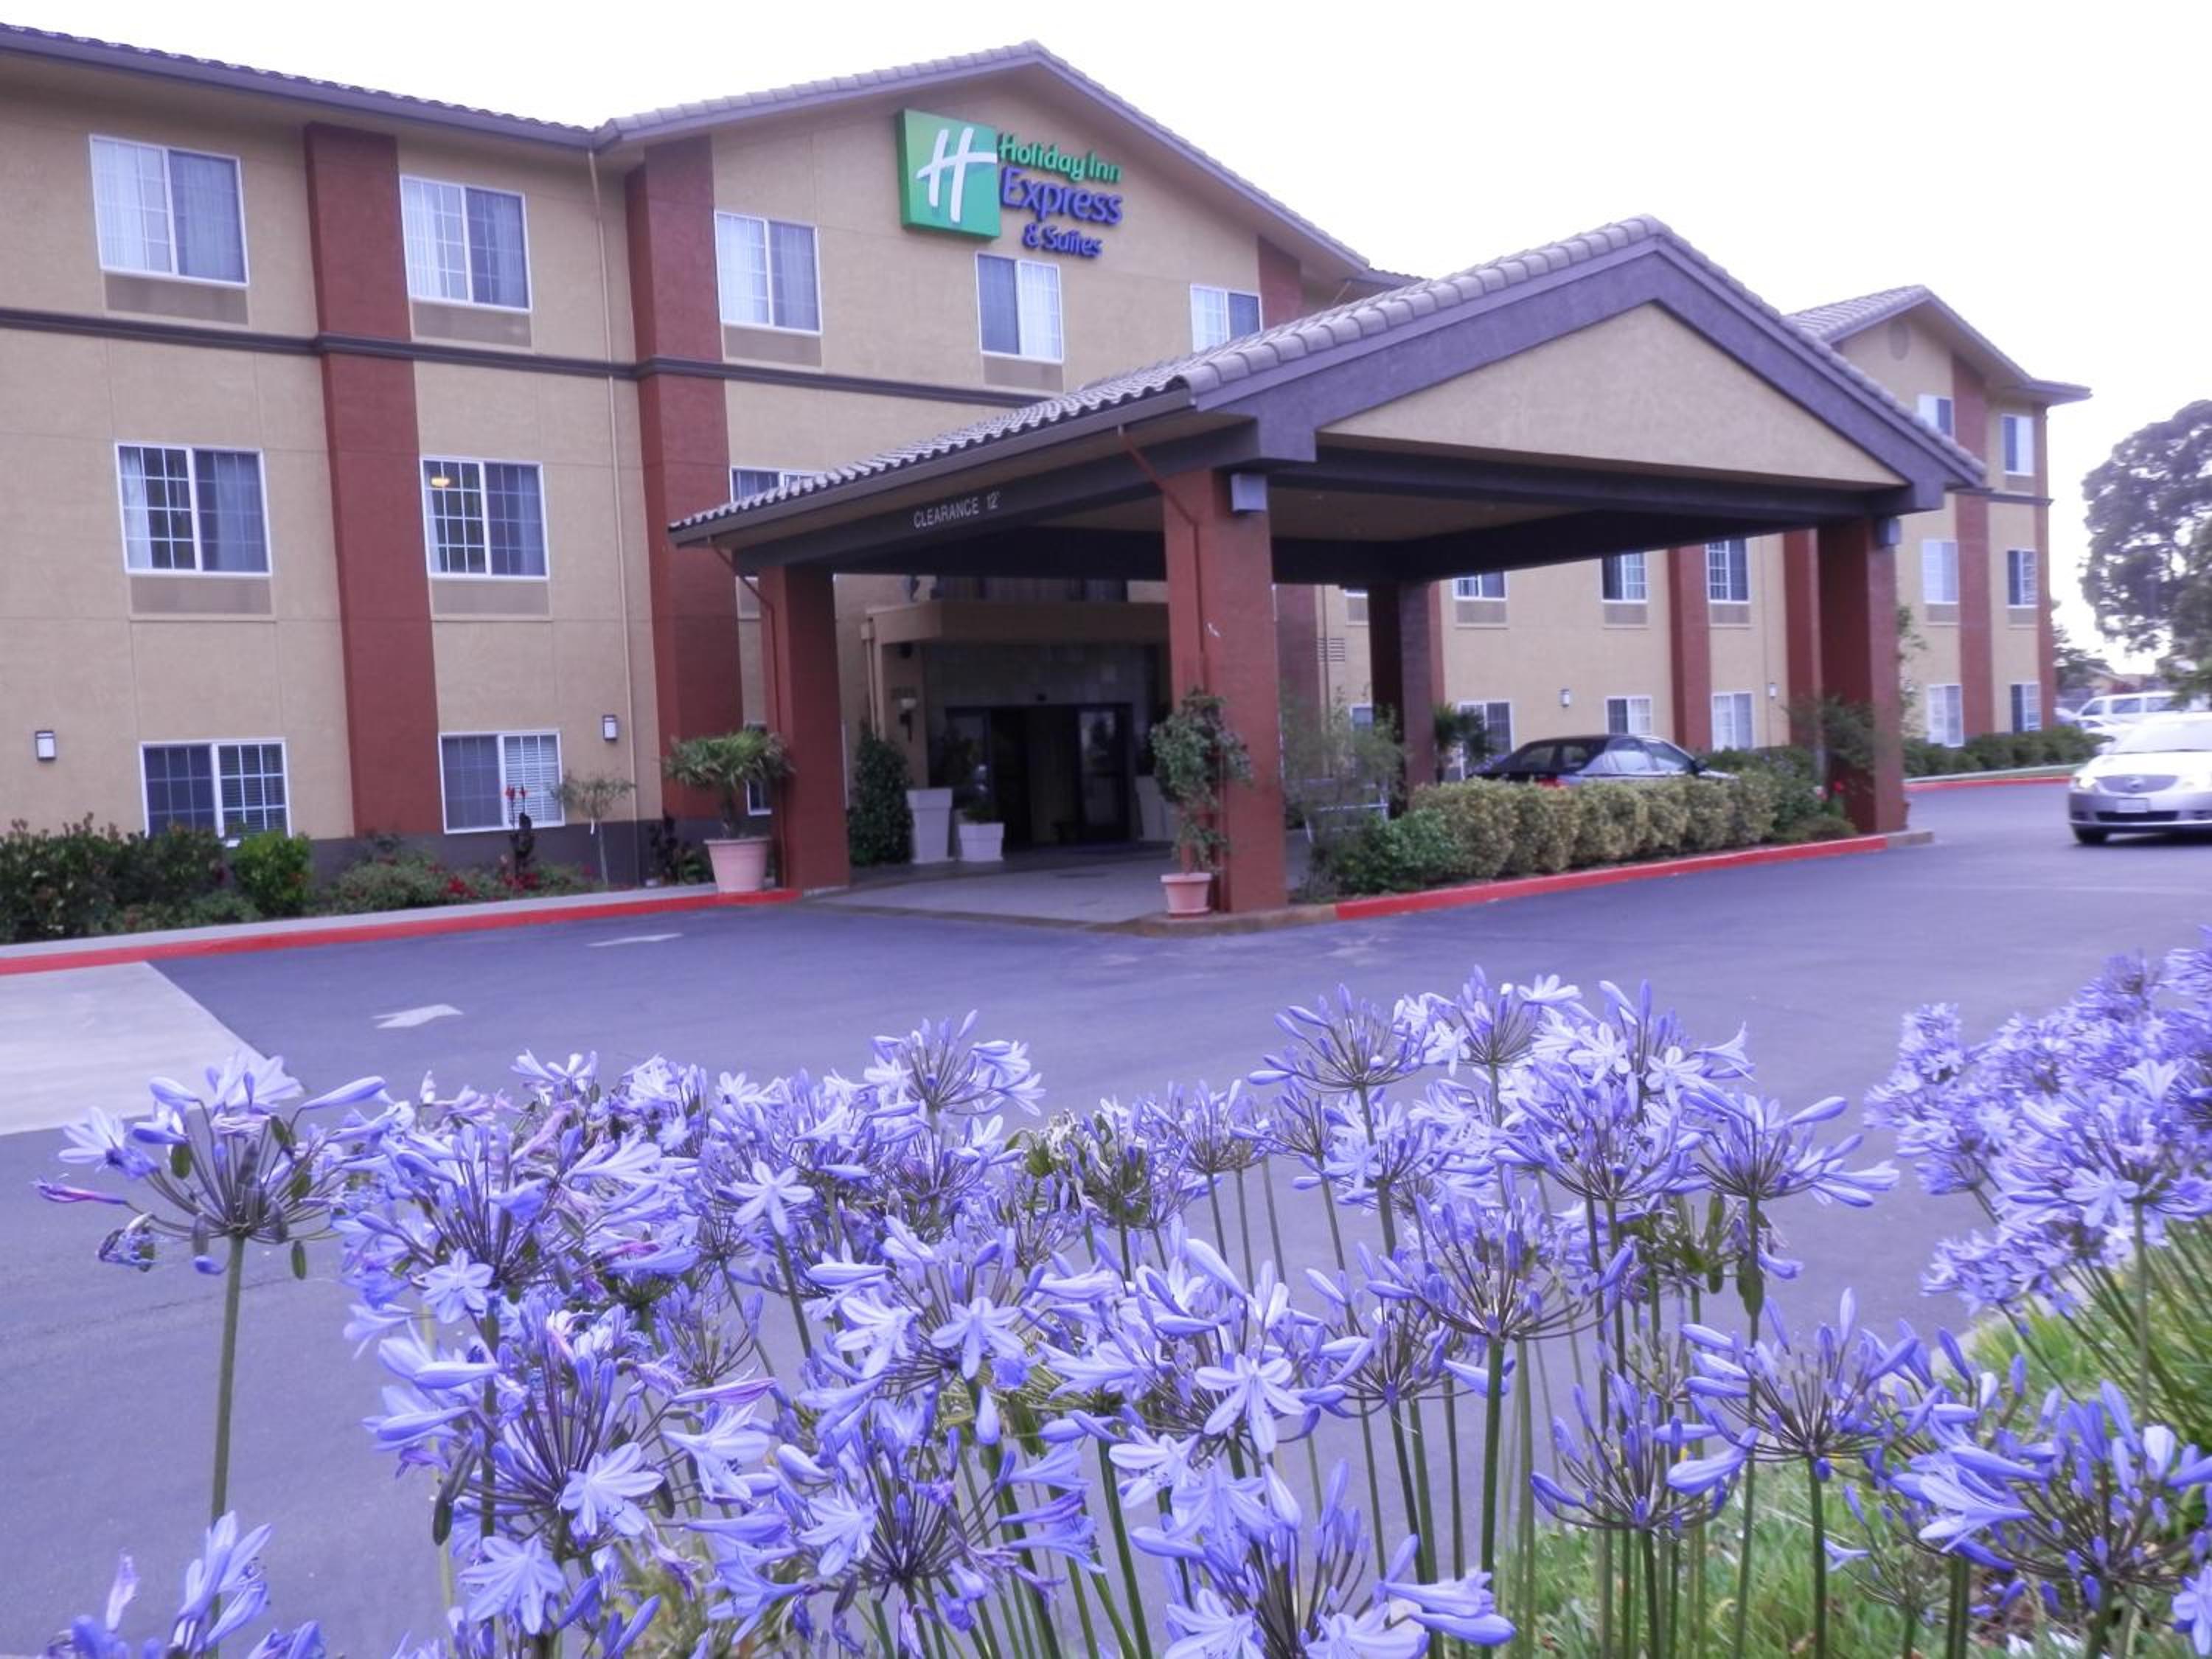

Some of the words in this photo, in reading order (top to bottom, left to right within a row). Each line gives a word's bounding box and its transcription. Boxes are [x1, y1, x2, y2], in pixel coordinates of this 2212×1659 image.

[996, 132, 1086, 183] Holiday
[1088, 150, 1122, 184] Inn
[1000, 164, 1122, 226] Express
[1022, 222, 1040, 251] &
[1040, 225, 1102, 258] Suites
[914, 496, 980, 529] CLEARANCE
